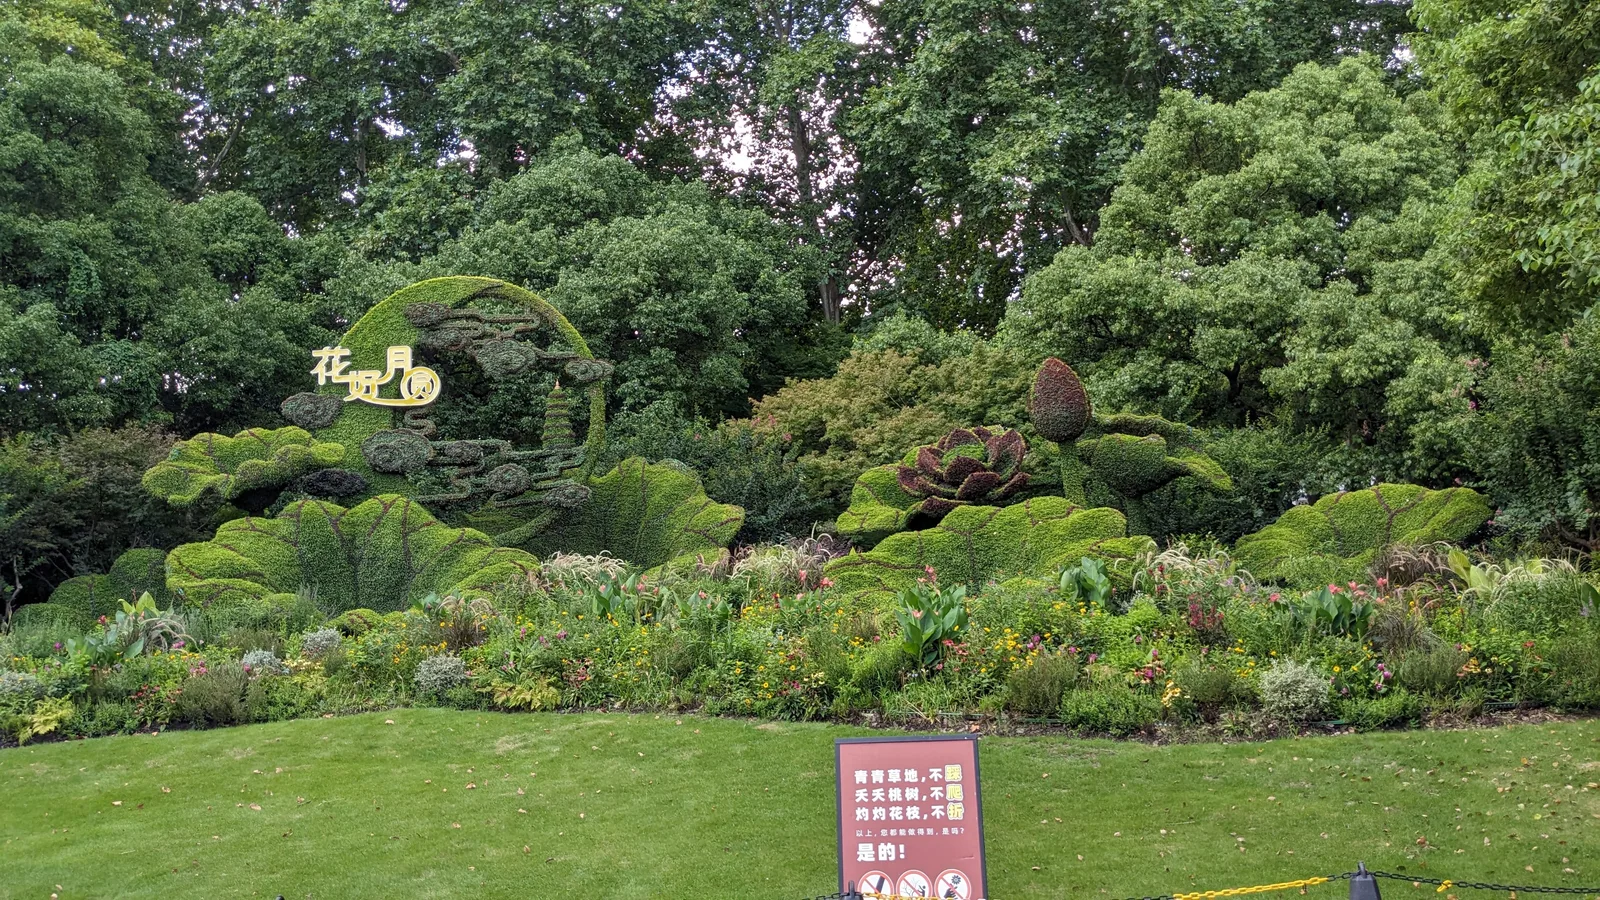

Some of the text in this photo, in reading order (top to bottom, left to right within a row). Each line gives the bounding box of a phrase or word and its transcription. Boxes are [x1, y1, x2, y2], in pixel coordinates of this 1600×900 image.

[310, 346, 440, 406] 花好月圆
[855, 802, 964, 821] 灼灼花枝，不折
[857, 843, 905, 862] 是的！
